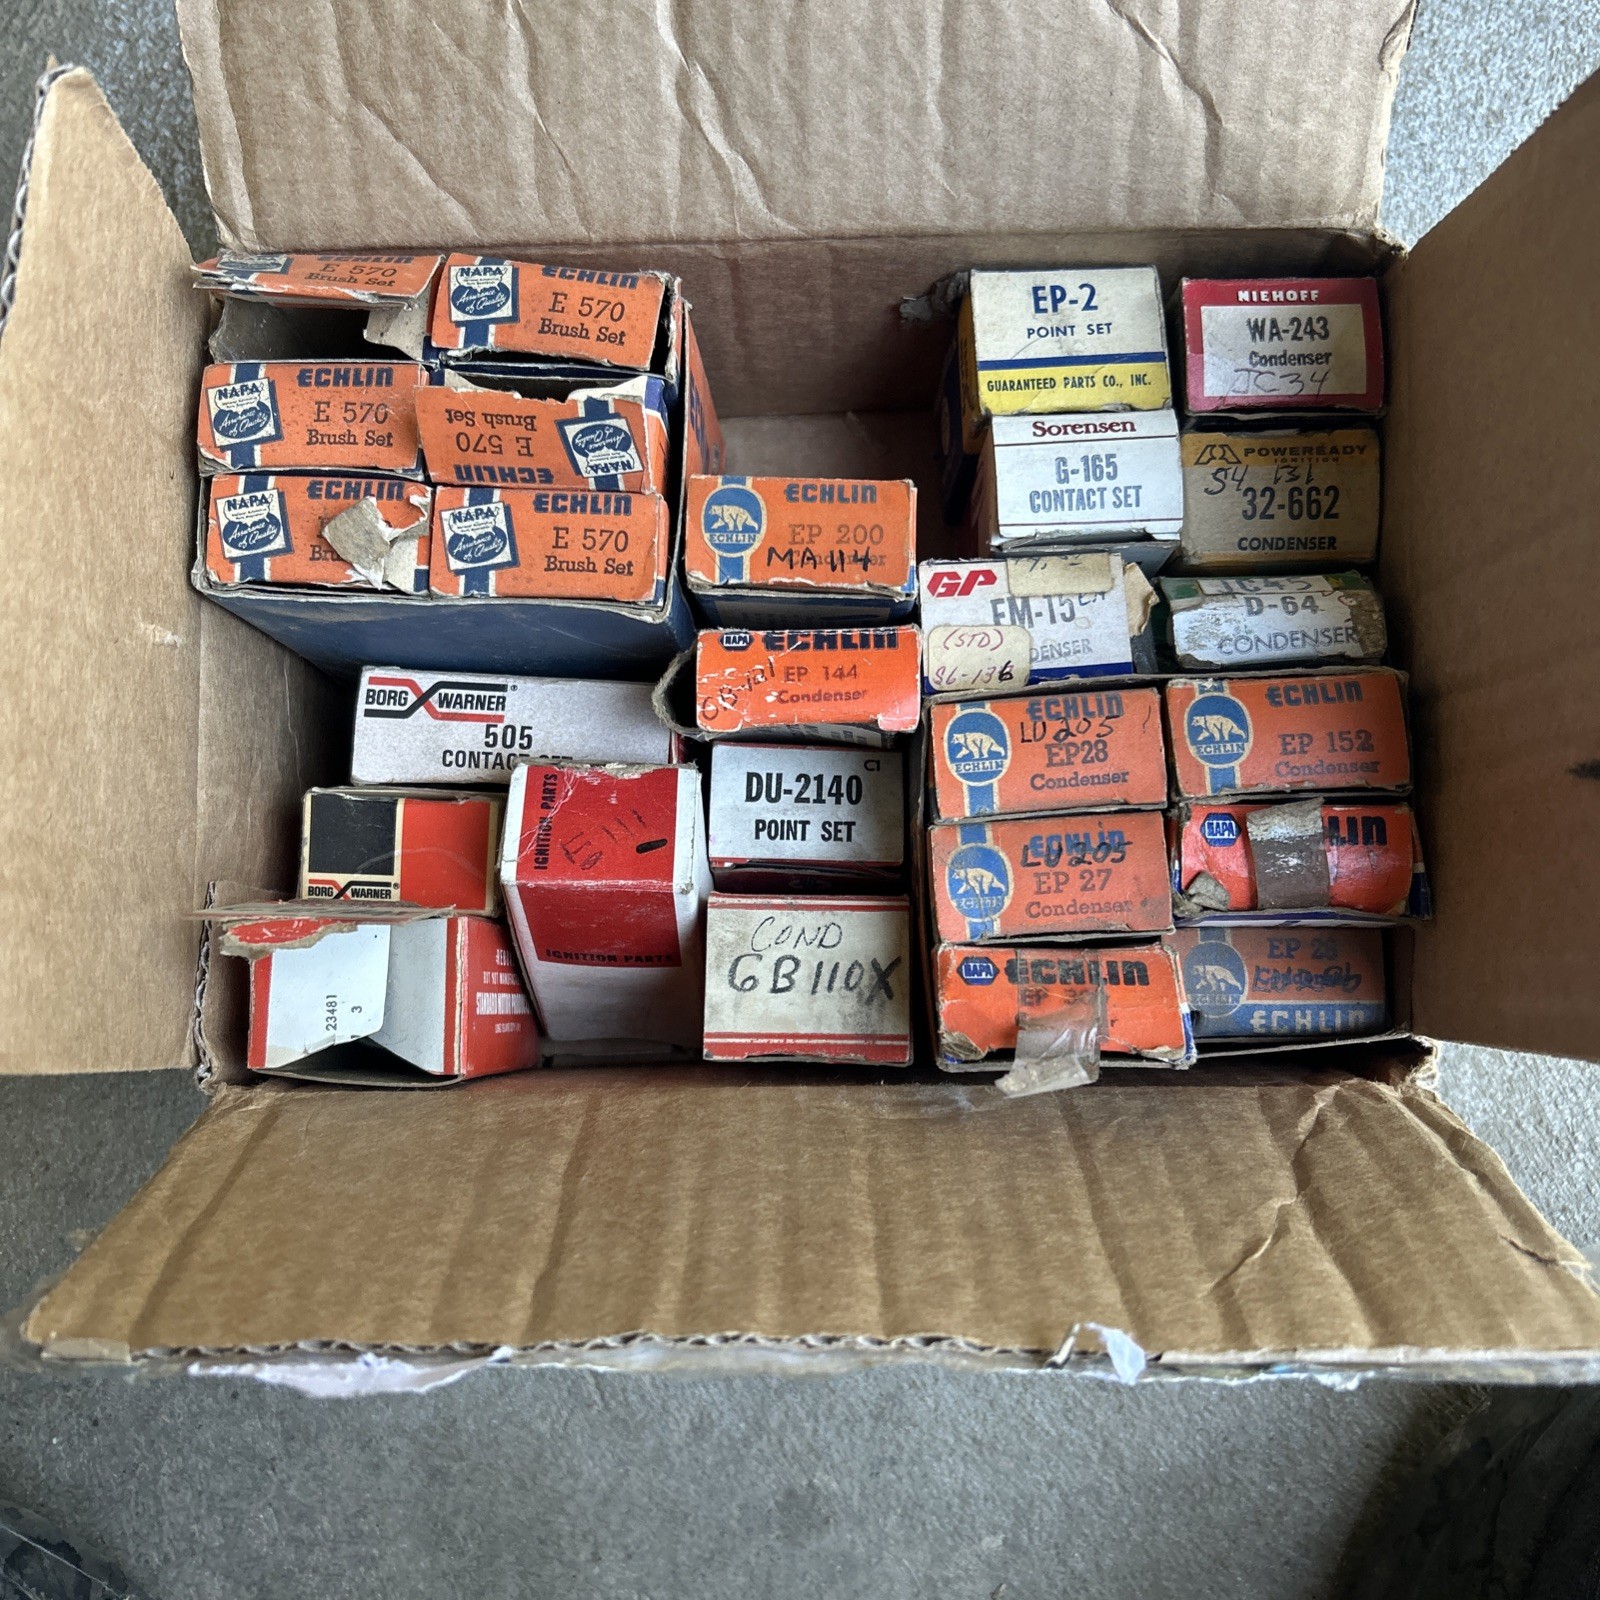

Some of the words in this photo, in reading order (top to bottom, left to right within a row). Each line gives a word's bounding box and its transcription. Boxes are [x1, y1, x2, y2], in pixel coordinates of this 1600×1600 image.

[305, 272, 357, 284] Brush
[364, 277, 396, 287] Set
[319, 263, 337, 273] E
[349, 265, 397, 277] 570
[460, 266, 502, 277] NAPA
[542, 265, 639, 289] ECHLIN
[476, 292, 506, 310] Quality
[1032, 283, 1098, 314] EP-2
[1238, 290, 1319, 302] NIEHOFF
[549, 292, 567, 313] E
[578, 297, 625, 323] 570
[538, 318, 590, 340] Brush
[596, 326, 626, 346] Set
[1027, 325, 1076, 339] POINT
[1087, 322, 1113, 336] SET
[1247, 316, 1330, 343] WA-243
[1249, 351, 1333, 367] Condenser
[297, 367, 394, 388] ECHLIN
[987, 378, 1056, 392] GUARANTEED
[1063, 375, 1096, 389] PARTS
[1130, 373, 1151, 386] INC.
[218, 382, 262, 400] NAPA
[314, 401, 330, 423] E
[342, 401, 388, 425] 570
[445, 408, 475, 426] Set
[481, 412, 537, 432] Brush
[306, 429, 358, 447] Brush
[364, 430, 394, 448] Set
[1032, 421, 1137, 438] Sorensen
[456, 432, 503, 455] 570
[517, 436, 535, 458] E
[1244, 445, 1368, 458] POWEREADY
[453, 464, 555, 485] ECHLIN
[589, 460, 633, 475] NAPA
[1055, 454, 1118, 484] G-165
[306, 480, 406, 500] ECHLIN
[784, 483, 878, 504] ECHLIN
[1029, 487, 1107, 513] CONTACT
[1112, 485, 1142, 509] SET
[226, 493, 270, 512] NAPA
[532, 493, 632, 515] ECHLIN
[1242, 485, 1340, 521] 32-662
[451, 506, 496, 522] NAPA
[248, 524, 278, 545] Quality
[552, 526, 569, 549] E
[582, 528, 629, 552] 570
[708, 533, 758, 544] ECHLIN
[788, 524, 822, 545] EP
[836, 524, 884, 545] 200
[1237, 536, 1337, 551] CONDENSER
[309, 544, 350, 562] Bru
[544, 555, 598, 573] Brush
[604, 558, 634, 576] Set
[927, 570, 998, 598] GP
[1245, 595, 1319, 616] D-64
[723, 634, 750, 646] NAPA
[762, 631, 898, 651] ECHLIN
[1031, 638, 1094, 663] DENSER
[1218, 626, 1360, 656] CONDENSER
[784, 666, 808, 682] EP
[822, 664, 858, 682] 144
[365, 688, 409, 707] BORG
[438, 691, 507, 712] WARNER
[777, 689, 868, 704] Condenser
[1265, 680, 1364, 708] ECHLIN
[1026, 693, 1125, 722] ECHLIN
[484, 723, 533, 750] 505
[1279, 733, 1314, 756] EP
[1326, 729, 1375, 754] 152
[1196, 742, 1246, 755] ECHLIN
[442, 749, 530, 770] CONTAC
[954, 761, 1004, 773] ECHLIN
[1275, 759, 1381, 779] Condenser
[541, 773, 558, 810] PARTS
[745, 772, 863, 805] DU-2140
[1030, 771, 1129, 791] Condenser
[754, 819, 811, 842] POINT
[821, 821, 857, 843] SET
[1206, 822, 1236, 837] NAPA
[1327, 816, 1388, 846] LIN
[534, 816, 553, 870] IGNITION
[1034, 872, 1070, 895] EP
[1079, 868, 1113, 892] 27
[308, 886, 334, 898] BORG
[351, 888, 392, 900] WARNER
[1025, 899, 1133, 919] Condenser
[751, 916, 843, 952] COND
[546, 949, 618, 963] IGNITION
[624, 954, 675, 964] PARTS
[1267, 937, 1301, 960] EP
[963, 963, 994, 978] NAPA
[1004, 958, 1150, 986] ECHLIN
[326, 994, 338, 1032] 23481
[351, 1005, 363, 1014] 3
[1250, 1009, 1366, 1034] ECHLIN
